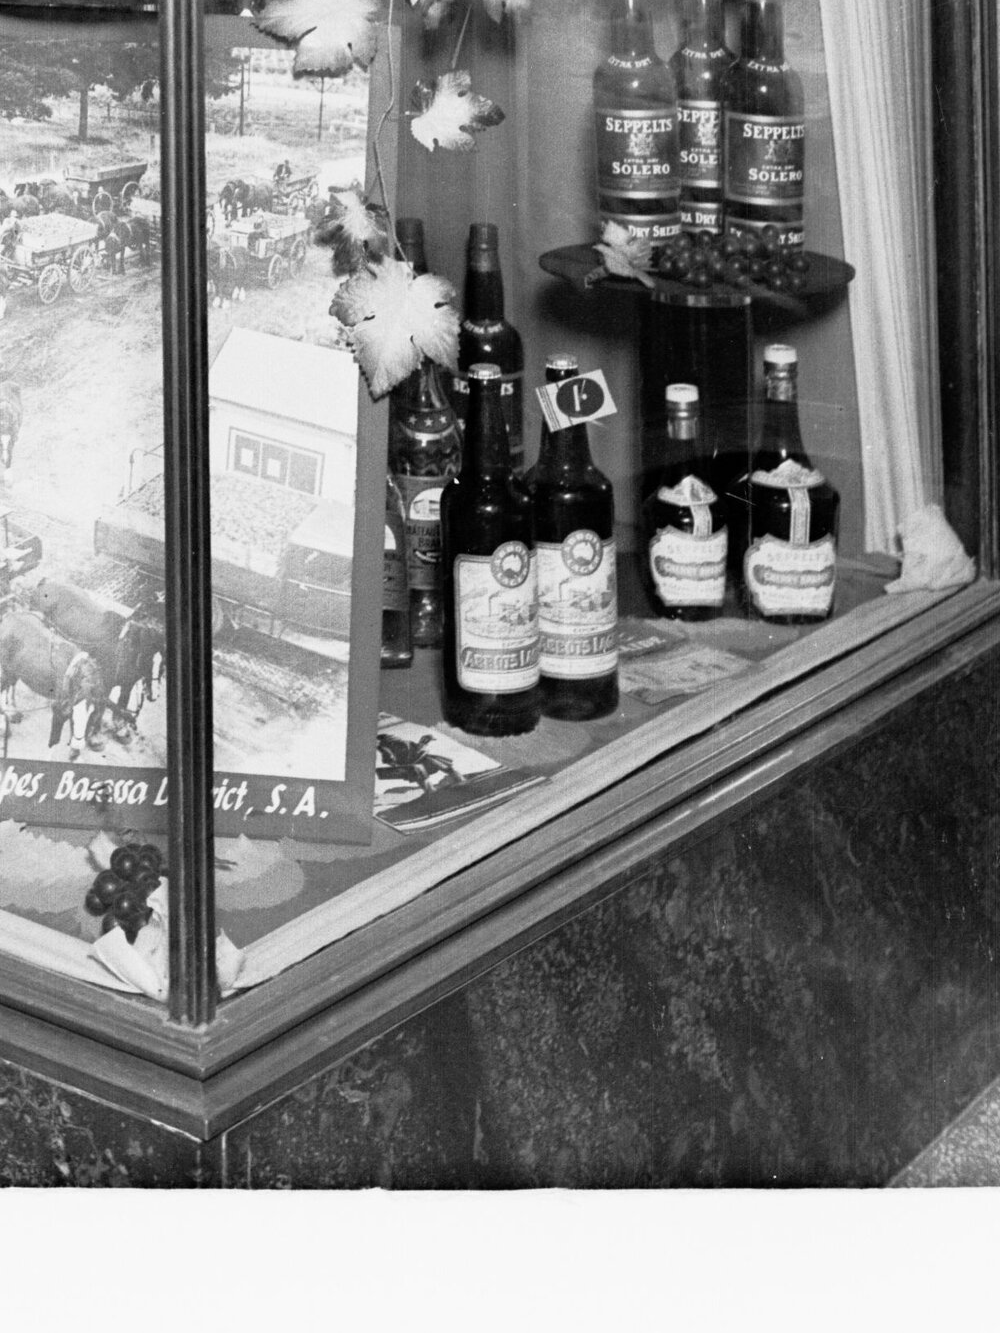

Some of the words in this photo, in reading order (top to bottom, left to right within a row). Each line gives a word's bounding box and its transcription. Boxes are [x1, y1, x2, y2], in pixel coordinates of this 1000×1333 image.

[605, 117, 673, 134] SEPPELTS
[743, 122, 805, 140] SEPPELTS
[680, 150, 718, 165] SOLE
[612, 161, 671, 175] SOLERO
[748, 168, 802, 182] SOLERO
[695, 211, 718, 225] DRY
[627, 224, 650, 238] DRY
